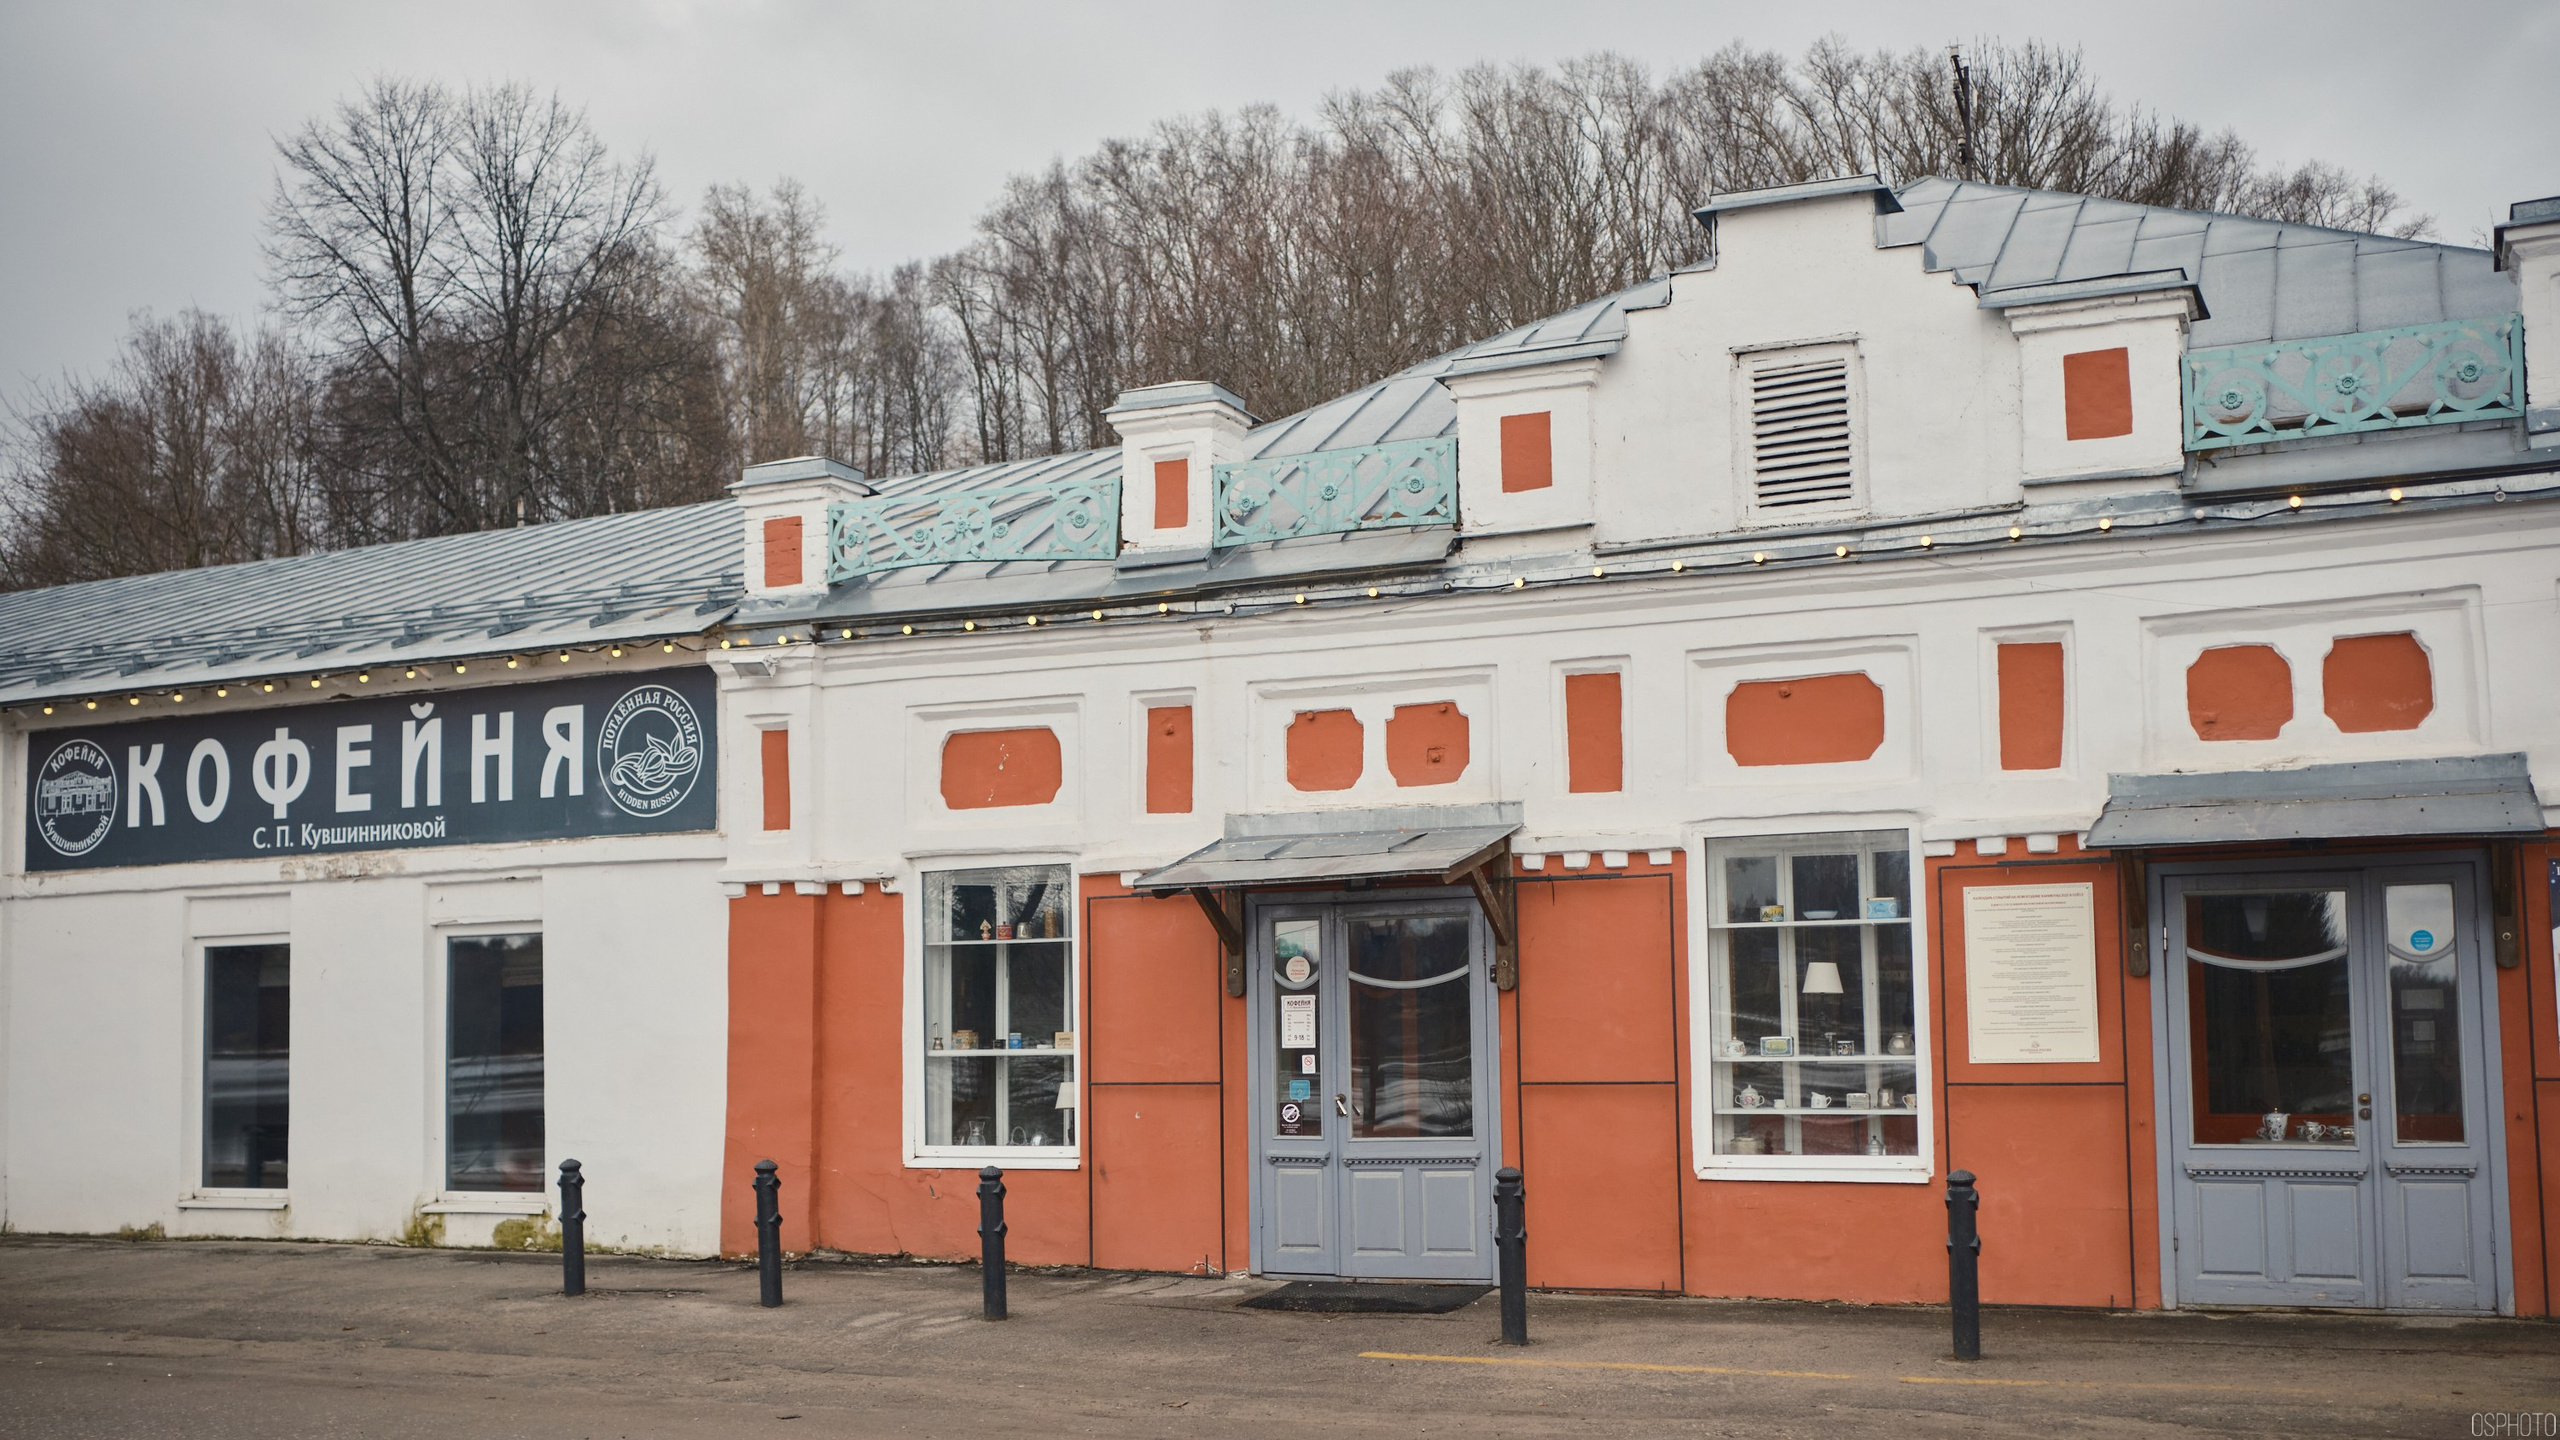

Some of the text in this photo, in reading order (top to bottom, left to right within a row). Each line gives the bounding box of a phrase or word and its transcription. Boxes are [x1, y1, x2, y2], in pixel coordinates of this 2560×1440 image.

[603, 691, 698, 750] ПОТАЁННАЯ РОССИЯ
[50, 745, 105, 773] КОФЕЙНЯ
[127, 702, 584, 828] КОФЕЙНЯ
[617, 787, 680, 810] HIDDEN RUSSIA
[45, 815, 109, 852] Кувшинниковой
[252, 816, 446, 850] С. П. Кувшинниковой
[1286, 999, 1311, 1007] КОФЕЙНЯ
